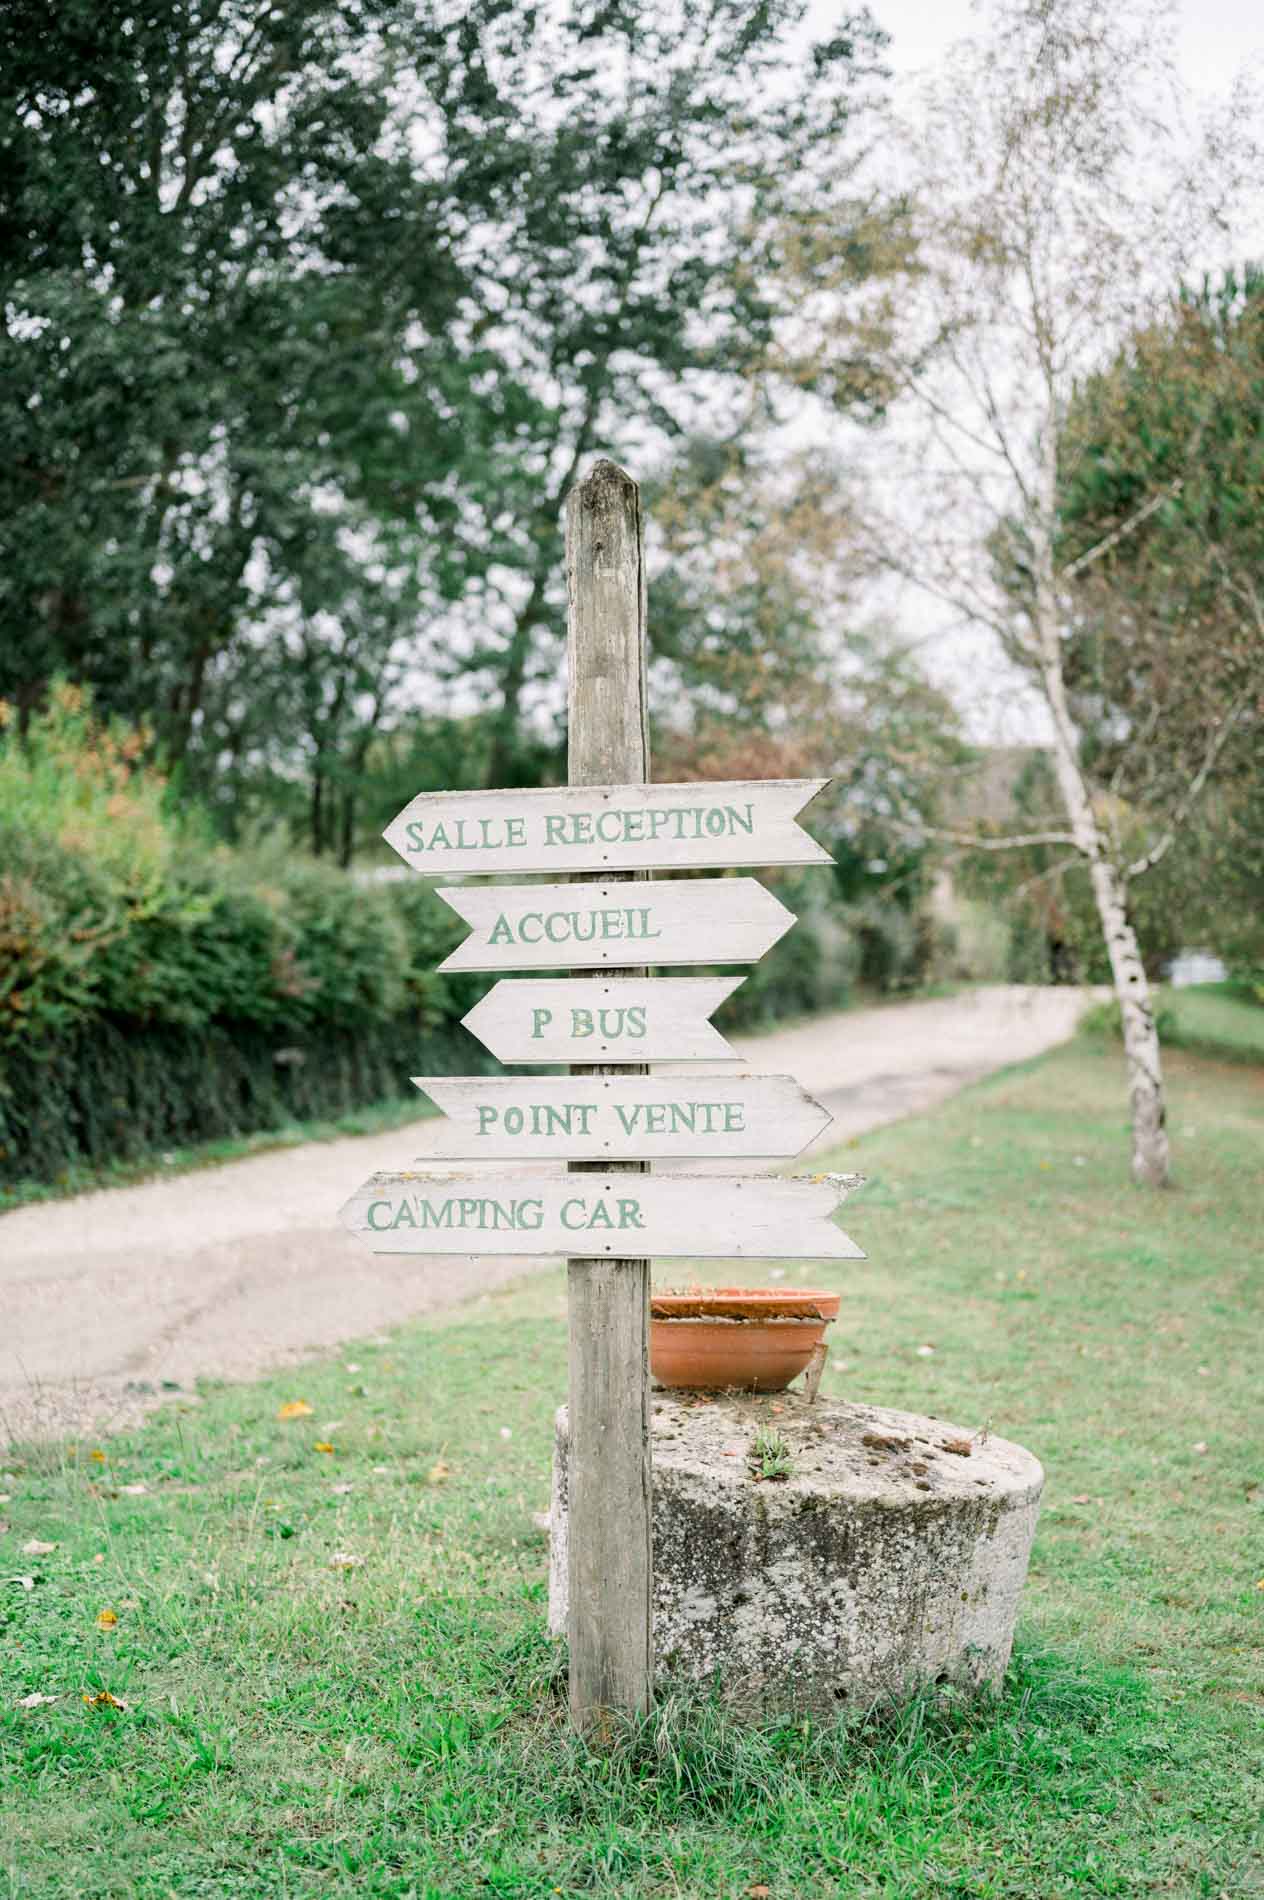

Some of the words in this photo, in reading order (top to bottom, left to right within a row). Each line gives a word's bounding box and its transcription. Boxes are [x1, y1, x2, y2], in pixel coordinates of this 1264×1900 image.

[405, 816, 528, 853] SALLE
[543, 803, 755, 847] RECEPTION
[487, 908, 661, 945] ACCUEIL
[531, 1007, 553, 1039] P
[571, 1007, 647, 1039] BUS
[475, 1103, 598, 1137] POINT
[614, 1102, 746, 1136] VENTE
[366, 1199, 544, 1232] CAMPING
[559, 1199, 646, 1230] CAR
